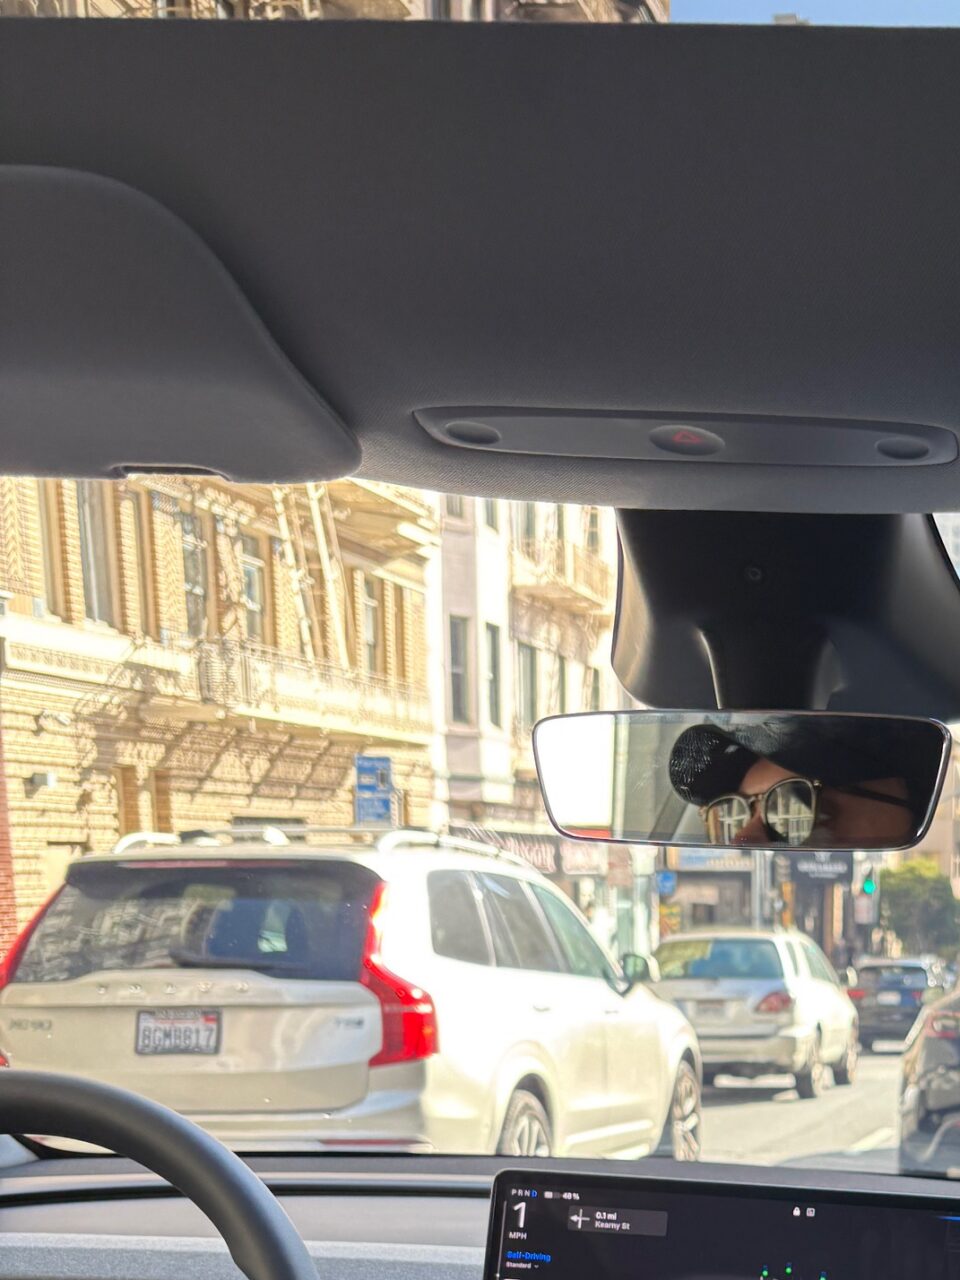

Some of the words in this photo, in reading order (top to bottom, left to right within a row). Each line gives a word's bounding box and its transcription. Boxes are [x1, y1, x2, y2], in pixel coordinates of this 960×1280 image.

[513, 1201, 527, 1229] 1
[595, 1211, 606, 1220] 0.1
[607, 1212, 618, 1221] mi
[595, 1220, 620, 1231] Kearny
[622, 1222, 631, 1230] St
[508, 1231, 528, 1241] MPH
[506, 1250, 552, 1263] Self-Driving
[506, 1261, 532, 1270] Standard
